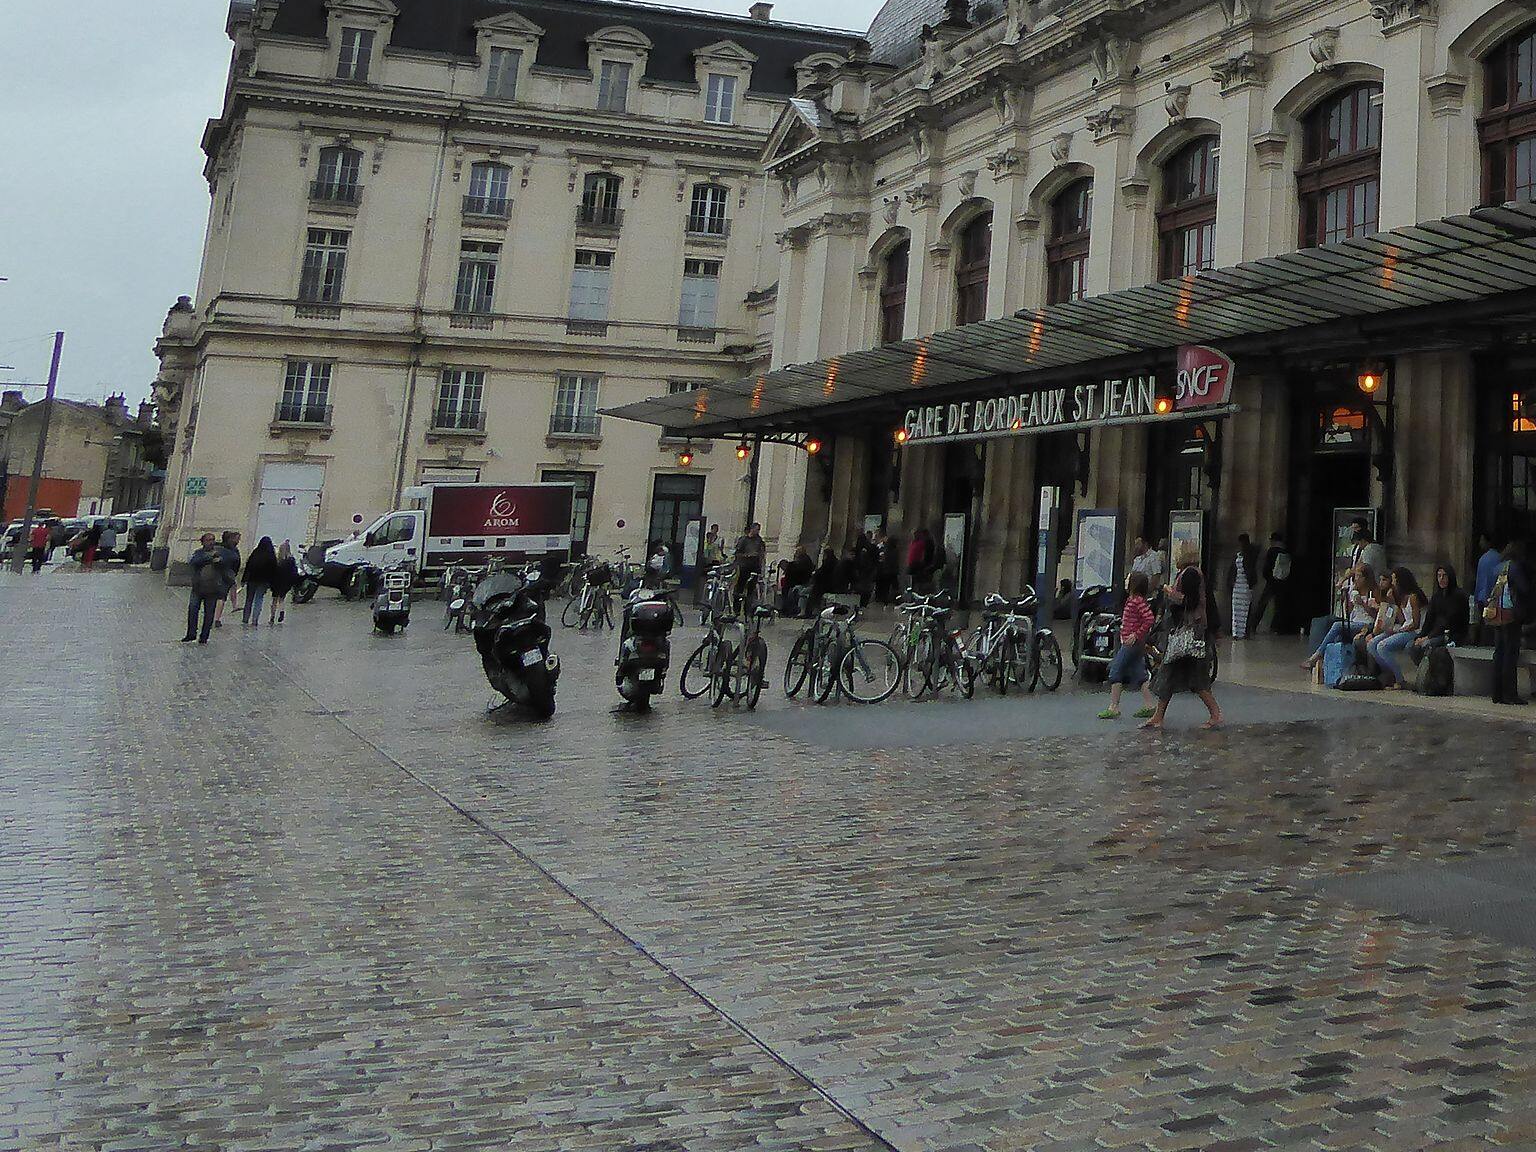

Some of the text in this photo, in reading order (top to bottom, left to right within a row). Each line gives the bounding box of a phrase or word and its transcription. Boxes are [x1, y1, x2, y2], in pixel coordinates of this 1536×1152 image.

[1175, 364, 1223, 400] SNCF
[904, 375, 1156, 439] GARE DE BORDEAUX ST JEAN
[483, 518, 520, 527] AROM
